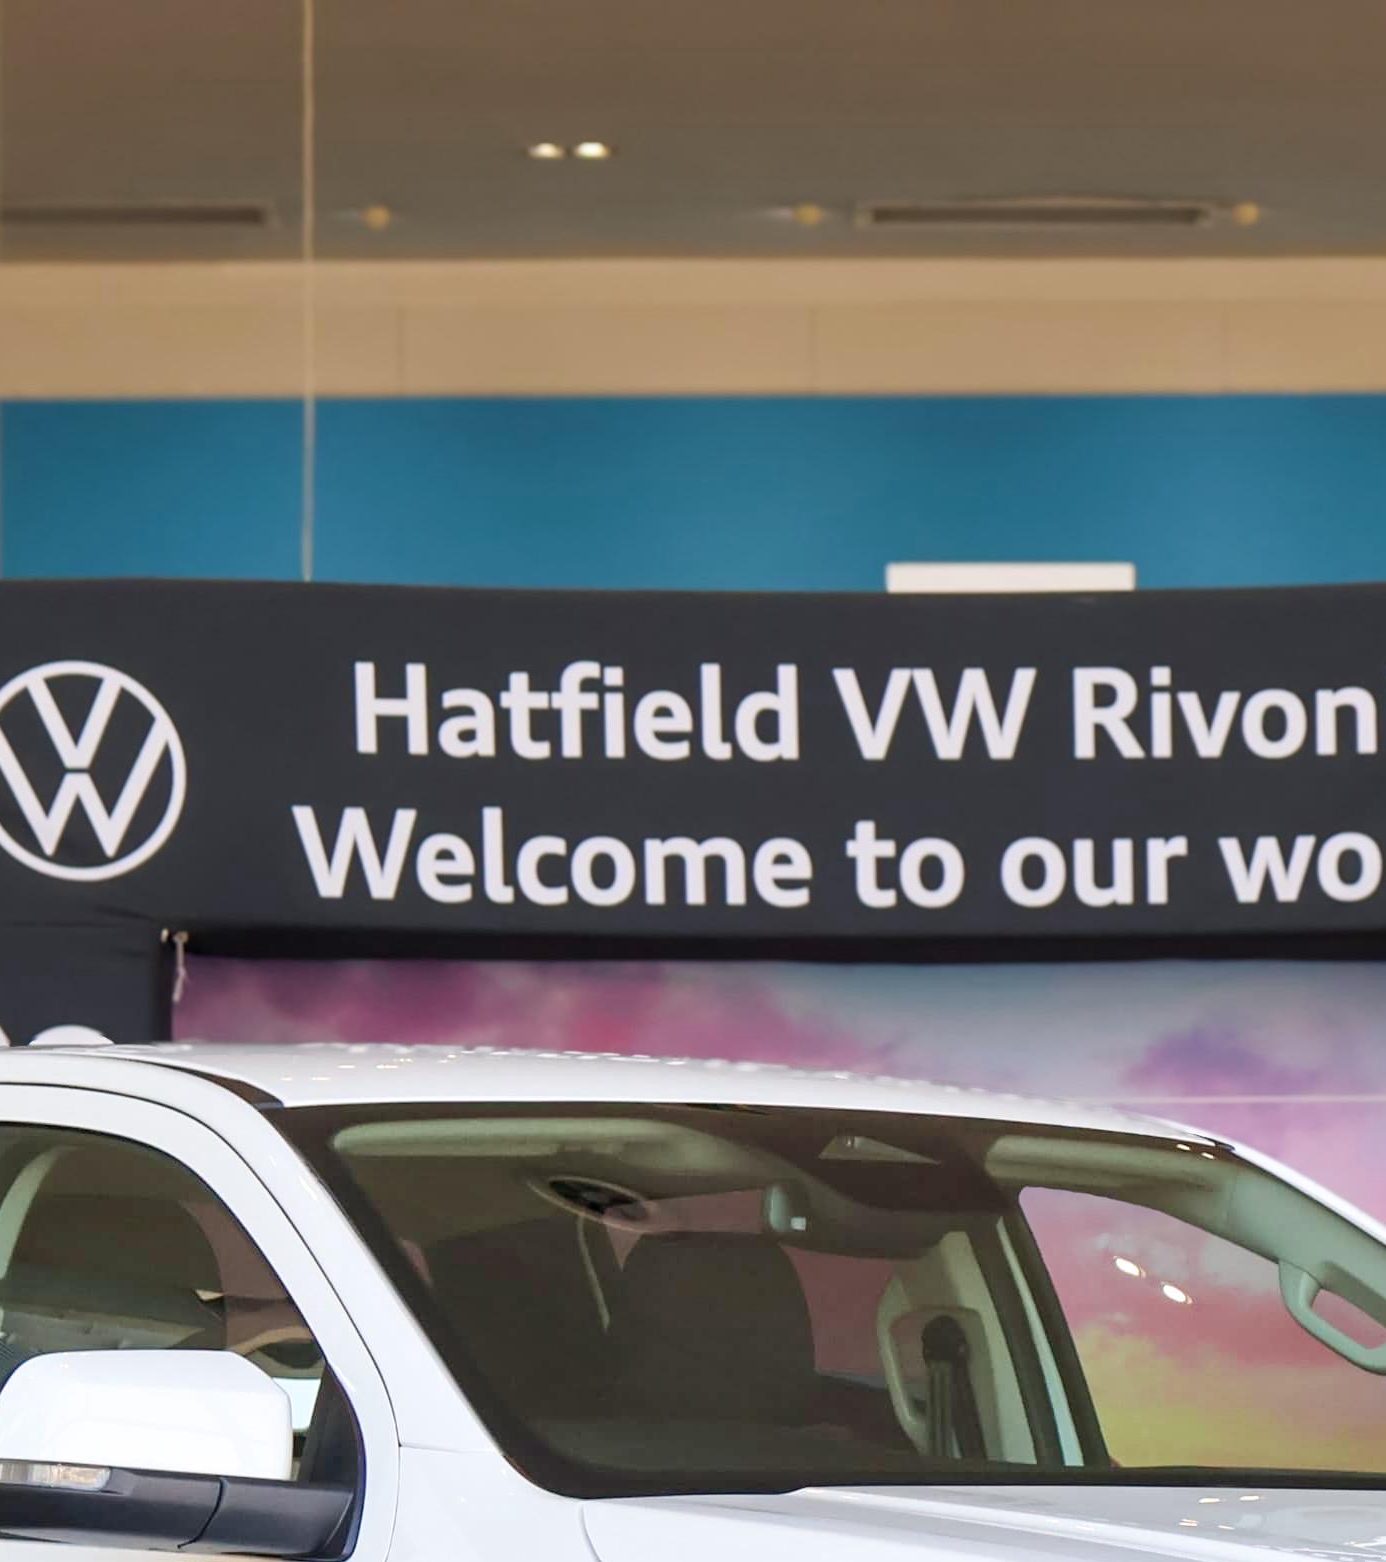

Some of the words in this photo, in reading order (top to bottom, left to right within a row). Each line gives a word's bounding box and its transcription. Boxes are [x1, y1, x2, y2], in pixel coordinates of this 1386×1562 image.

[353, 661, 800, 762] Hatfield
[832, 667, 1037, 760] VW
[291, 805, 813, 908] Welcome
[846, 820, 965, 908] to
[1001, 836, 1188, 907] our
